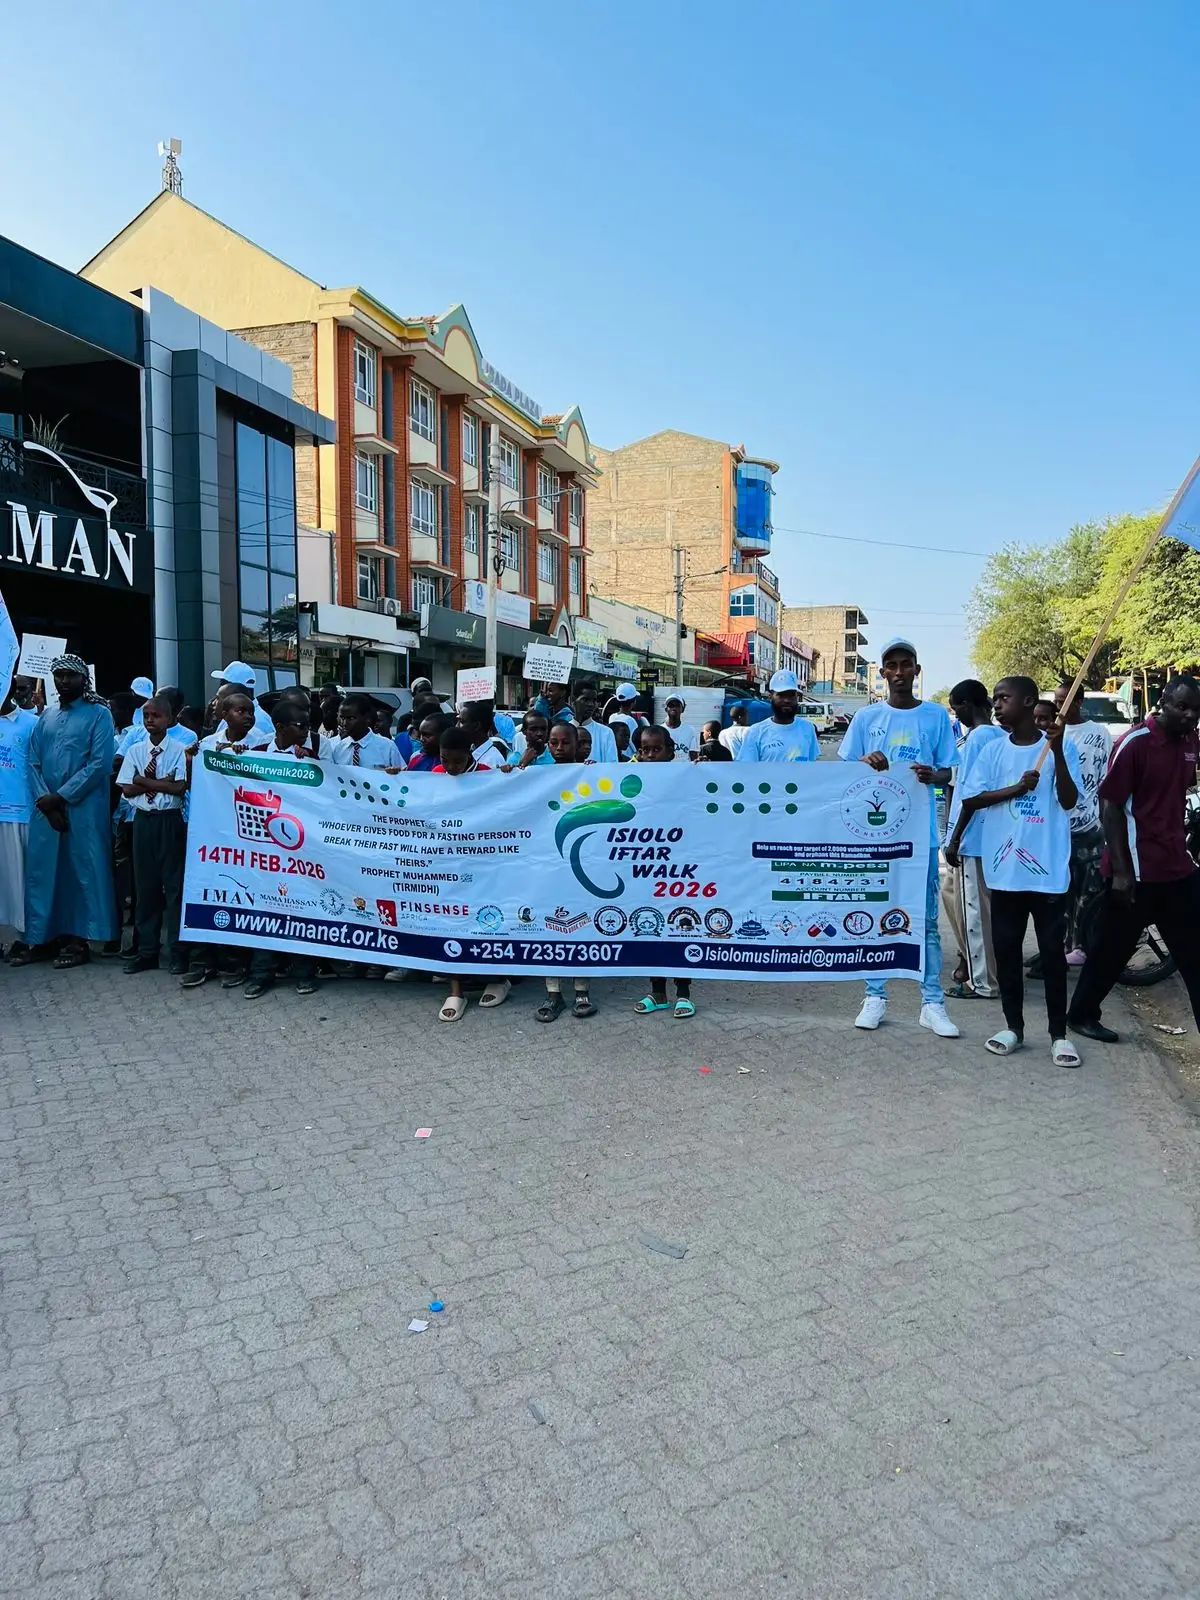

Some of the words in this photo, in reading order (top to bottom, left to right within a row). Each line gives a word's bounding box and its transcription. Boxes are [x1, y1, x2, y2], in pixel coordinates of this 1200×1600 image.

[514, 385, 541, 421] PLAZA
[0, 500, 137, 587] MAN
[1020, 808, 1041, 817] WALK
[1026, 816, 1045, 824] 2026
[372, 814, 388, 824] THE
[389, 816, 426, 828] PROPHET
[441, 819, 463, 829] SAID
[863, 818, 905, 838] NETWORK
[363, 826, 387, 837] GIVES
[388, 828, 411, 838] FOOD
[412, 829, 429, 839] FOR
[429, 831, 436, 840] A
[437, 830, 476, 842] FASTING
[478, 831, 517, 841] PERSON
[519, 829, 532, 839] TO
[607, 827, 684, 843] ISIOLO
[323, 835, 352, 846] BREAK
[353, 839, 378, 850] THEIR
[378, 841, 399, 852] FAST
[400, 843, 419, 854] WILL
[420, 845, 445, 855] HAVE
[447, 846, 454, 855] A
[456, 845, 497, 855] REWARD
[498, 845, 520, 854] LIKE
[608, 846, 672, 862] IFTAR
[198, 845, 245, 867] 14TH
[250, 851, 326, 880] FEB.2026
[361, 866, 400, 880] PROPHET
[402, 871, 459, 882] MUHAMMED
[632, 864, 699, 880] WALK
[392, 882, 440, 896] (TIRMIDHI)
[653, 881, 718, 898] 2026
[803, 893, 867, 901] IFTAR
[202, 888, 256, 907] IMAN
[260, 893, 283, 903] MAMA
[284, 897, 318, 908] HASSAN
[400, 901, 469, 916] FINSENSE
[235, 913, 399, 950] www.imanet.or.ke
[469, 943, 515, 959] +254
[520, 943, 623, 961] 723573607
